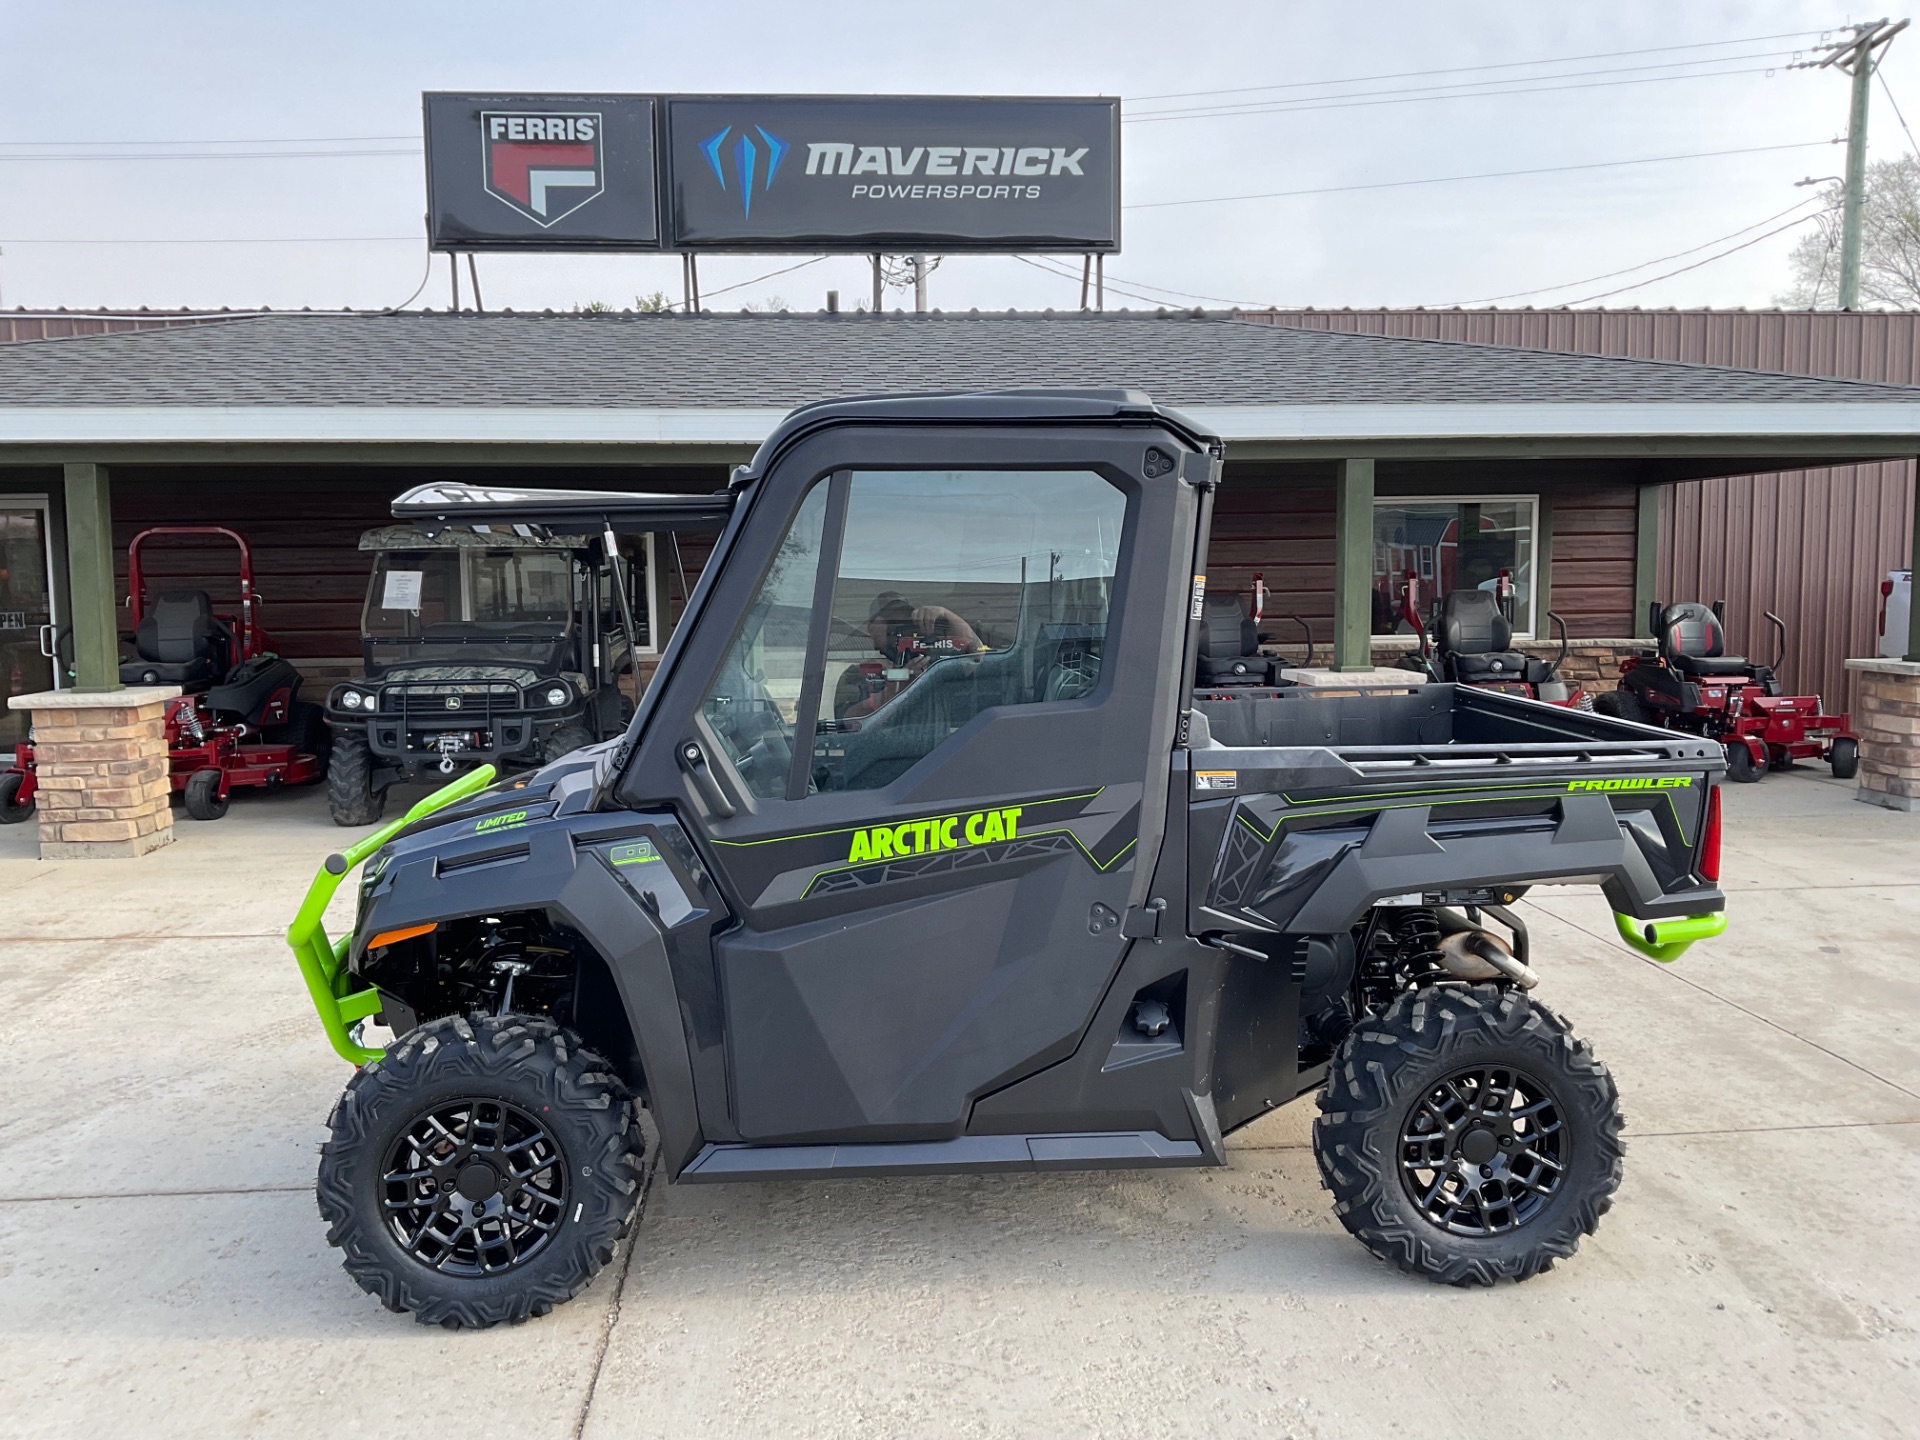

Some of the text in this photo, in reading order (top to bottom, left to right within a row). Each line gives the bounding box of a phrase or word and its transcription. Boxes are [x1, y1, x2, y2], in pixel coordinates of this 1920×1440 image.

[490, 117, 595, 141] FERRIS
[805, 143, 1090, 175] MAVERICK
[851, 185, 1041, 199] POWERSPORTS
[1567, 777, 1692, 791] PROWLER
[475, 811, 527, 831] LIMITED
[848, 807, 1022, 863] ARCTIC CAT
